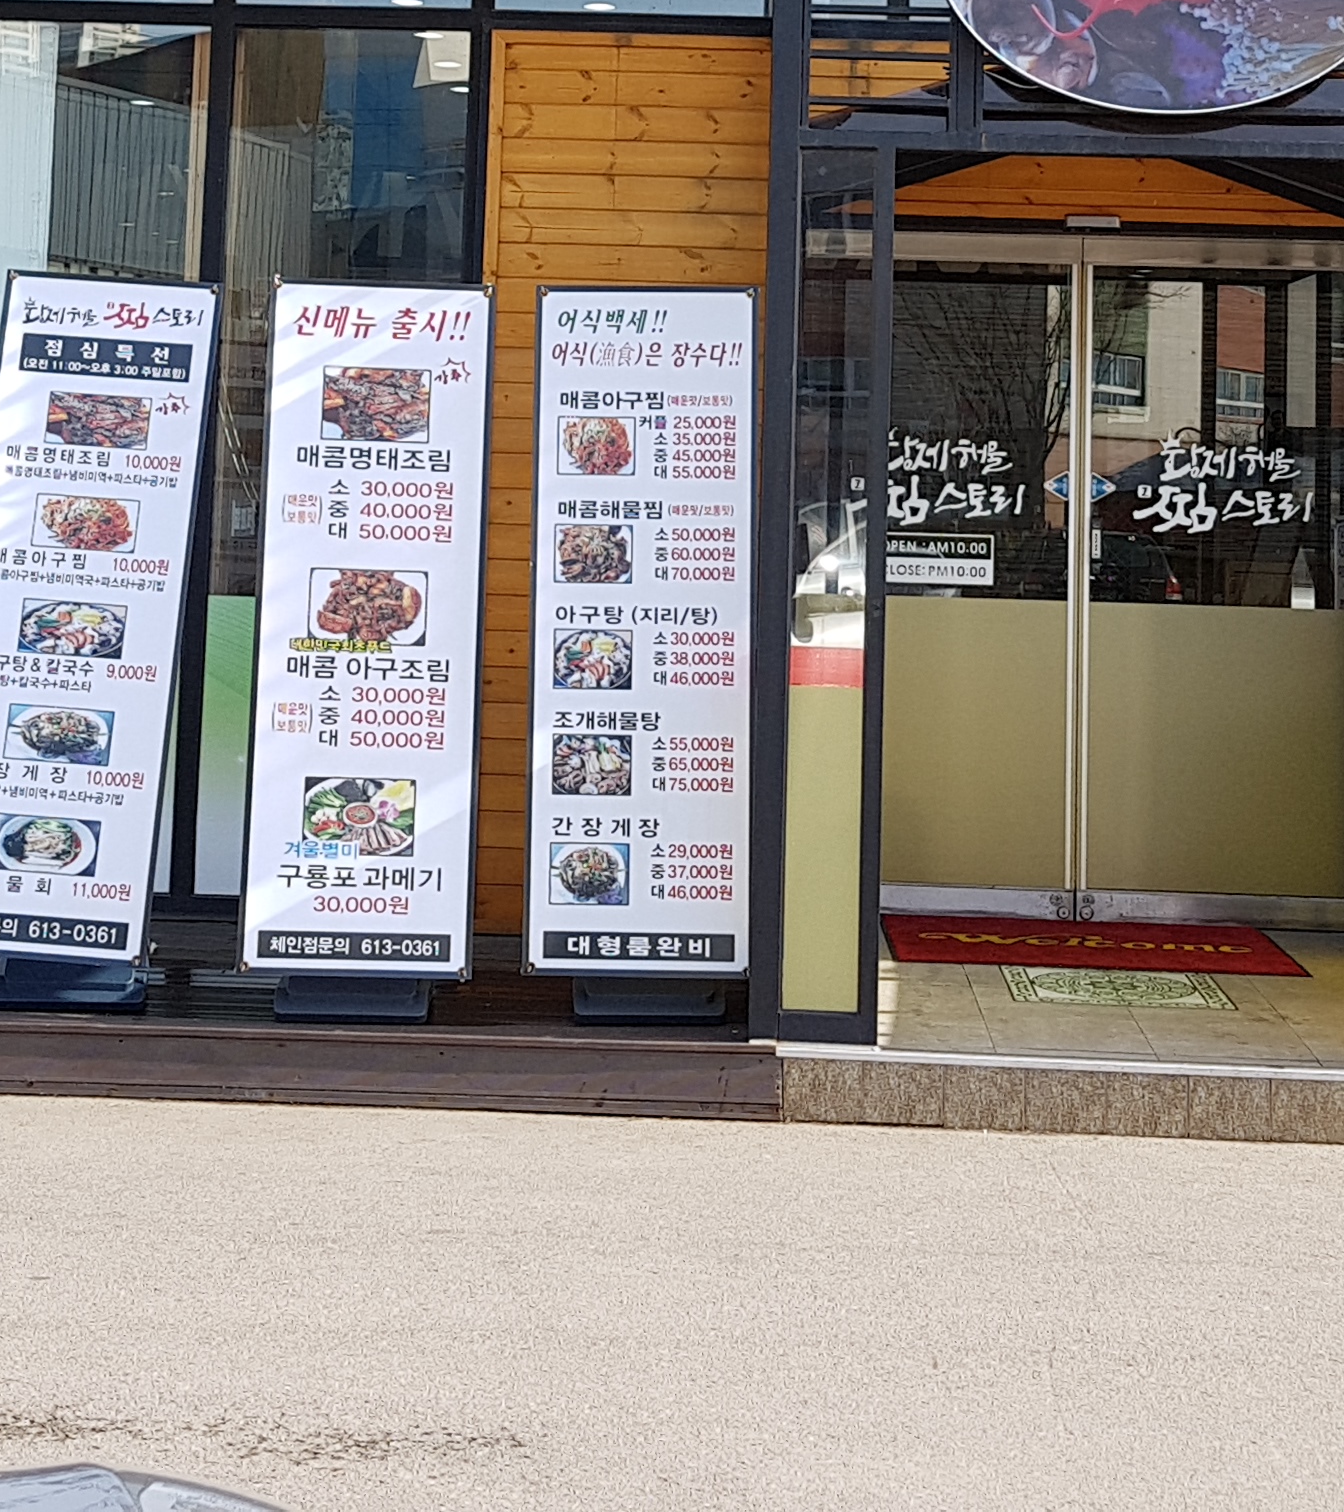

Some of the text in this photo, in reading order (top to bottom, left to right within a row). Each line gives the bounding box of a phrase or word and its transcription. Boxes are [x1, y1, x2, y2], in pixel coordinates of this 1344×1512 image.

[151, 307, 205, 328] 스토리
[292, 304, 472, 343] 신메뉴 출시!!
[557, 308, 668, 335] 어식백세!!
[670, 341, 744, 369] 장수다!!
[559, 390, 666, 411] 매콤아구찜
[638, 414, 737, 431] 커플 25,000원
[653, 431, 737, 447] 소 35,000원
[5, 444, 183, 473] 매콤명태조림 10,000원
[296, 444, 452, 474] 매콤명태조림
[653, 448, 736, 464] 중 45,000원
[653, 464, 736, 481] 대 55,000원
[327, 478, 455, 501] 소 30,000원
[933, 481, 1027, 519] 스토리
[327, 499, 454, 522] 중 40,000원
[557, 500, 664, 520] 매콤해물찜
[1221, 490, 1314, 527] 스토리
[328, 522, 453, 544] 대 50,000원
[654, 526, 736, 543] 소 50,000원
[654, 546, 669, 562] 중
[112, 557, 171, 577] 10,000원
[654, 566, 736, 582] 대 70,000원
[886, 564, 926, 576] LOSE:
[555, 605, 719, 626] 아구탕 (지리/탕)
[652, 631, 736, 647] 소 30,000원
[286, 654, 452, 683] 매콤 아구조림
[652, 651, 736, 667] 중 38,000원
[106, 662, 158, 683] 9,000원
[653, 670, 736, 687] 대 46,000원
[318, 685, 447, 707] 소 30,000원
[317, 706, 447, 729] 중 40,000원
[552, 710, 662, 732] 조개해물탕
[318, 729, 446, 751] 대 50,000원
[651, 736, 735, 753] 소 55,000원
[652, 756, 735, 773] 중 65,000원
[85, 769, 146, 790] 10,000원
[652, 776, 735, 794] 대 75,000원
[650, 843, 734, 860] 소 29,000원
[275, 863, 444, 893] 구룡포 과메기
[650, 863, 734, 881] 중 37,000원
[71, 882, 133, 902] 11,000원
[651, 884, 733, 901] 대 46,000원
[312, 894, 410, 916] 30,000원
[27, 920, 118, 946] 613-0361
[917, 932, 1254, 954] Welcome
[269, 935, 441, 958] 체인점문의 613-0361
[566, 935, 712, 960] 대형룸완비
